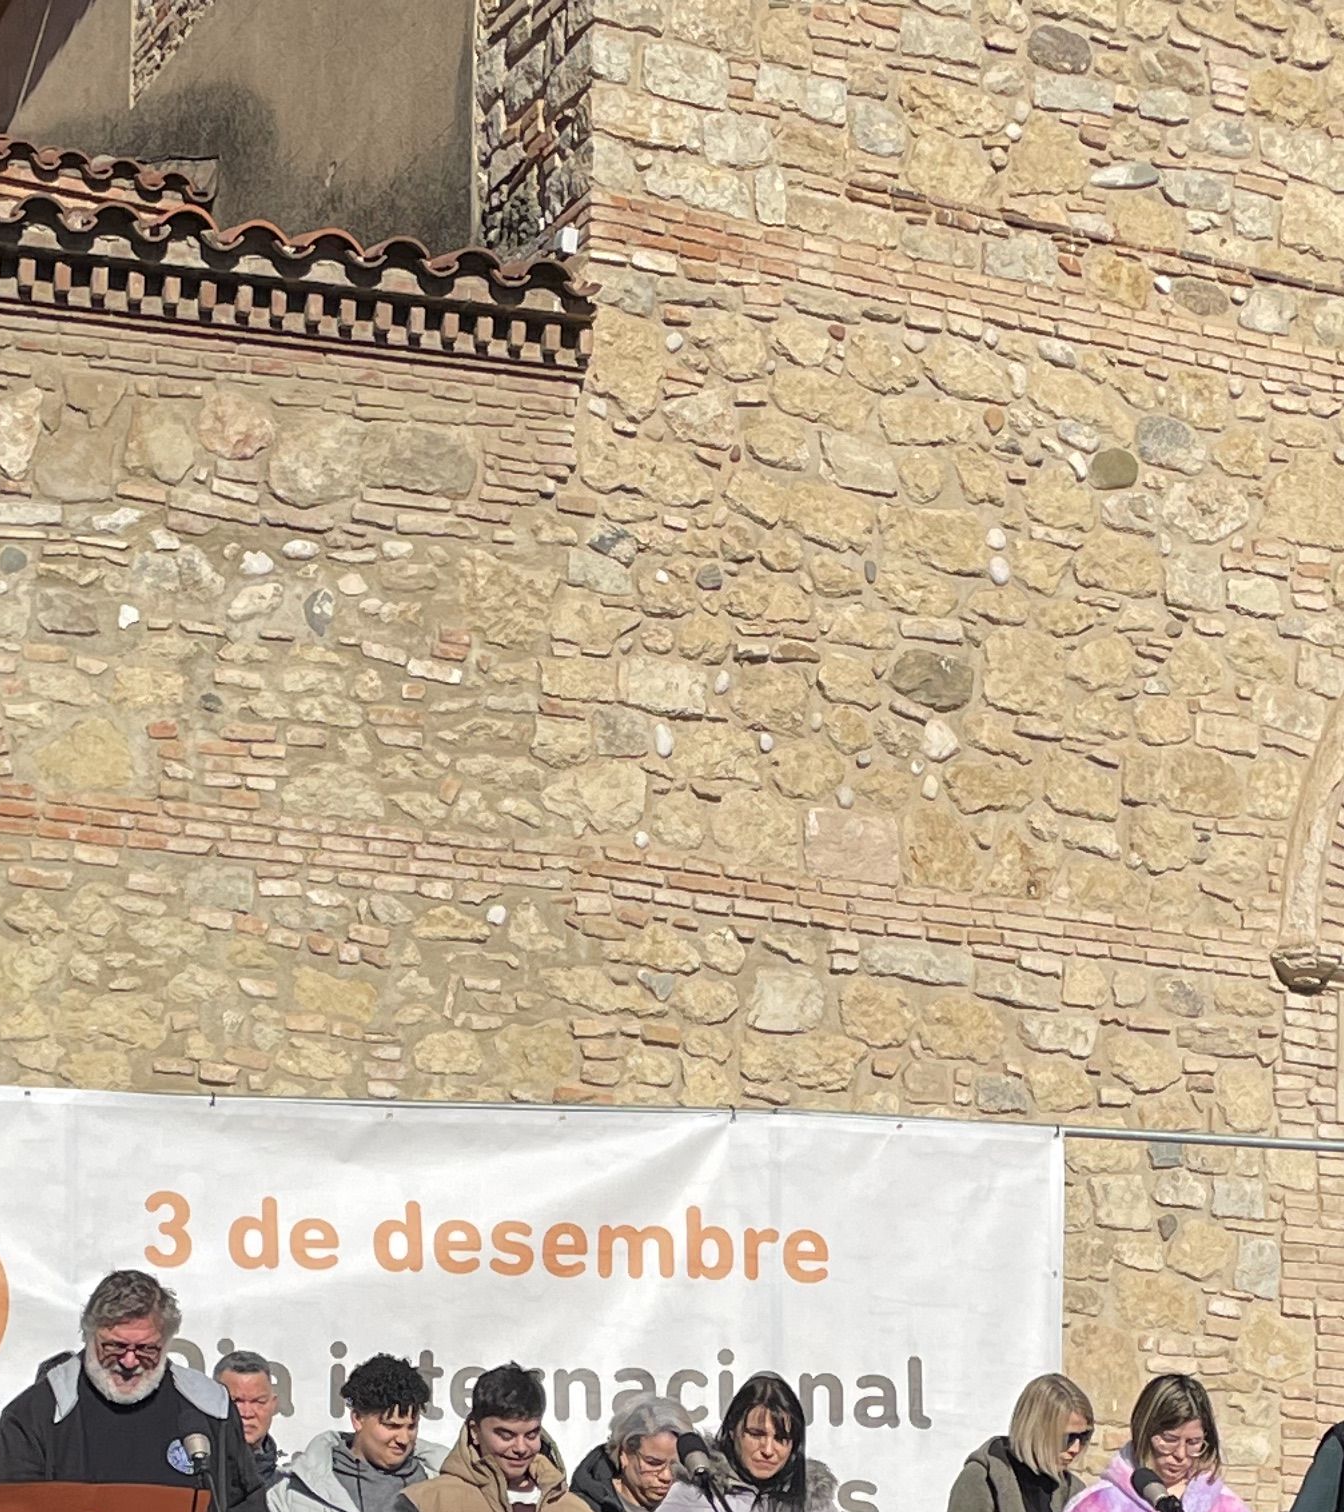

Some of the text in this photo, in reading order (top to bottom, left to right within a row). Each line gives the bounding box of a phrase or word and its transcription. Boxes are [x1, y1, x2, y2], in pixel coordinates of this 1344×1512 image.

[145, 1190, 829, 1285] 3 de desembre
